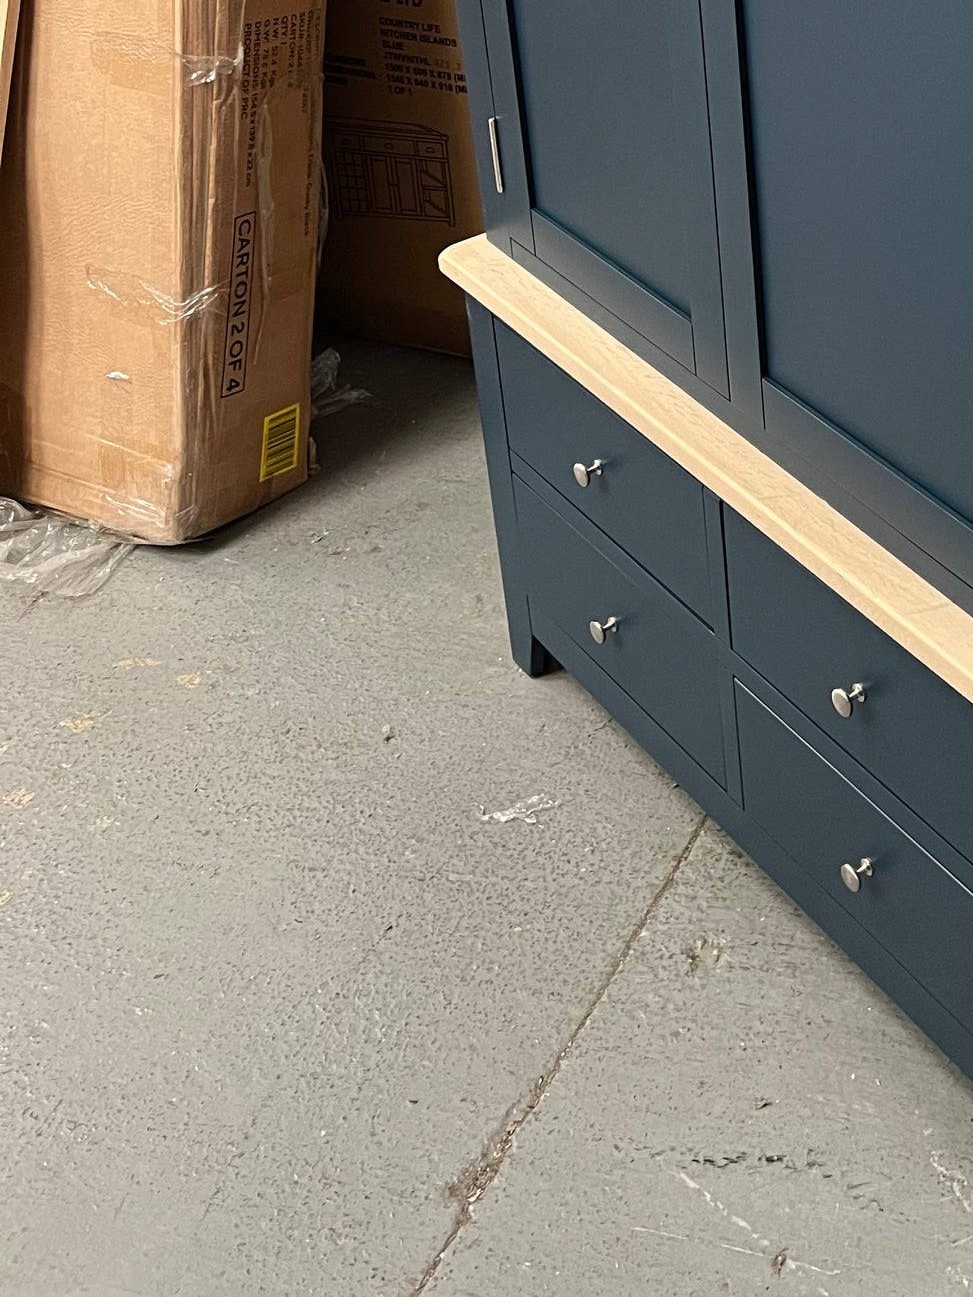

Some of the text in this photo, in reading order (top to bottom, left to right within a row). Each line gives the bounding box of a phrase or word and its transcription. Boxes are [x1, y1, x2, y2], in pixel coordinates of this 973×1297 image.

[379, 16, 440, 33] COUNTRY LIFE
[380, 29, 457, 47] KITCHEN ISLANDS
[382, 39, 404, 51] BLUE
[244, 23, 252, 77] PRODUCT
[242, 79, 250, 94] OF
[394, 86, 405, 95] OF
[226, 219, 250, 392] CARTON 2 OF 4
